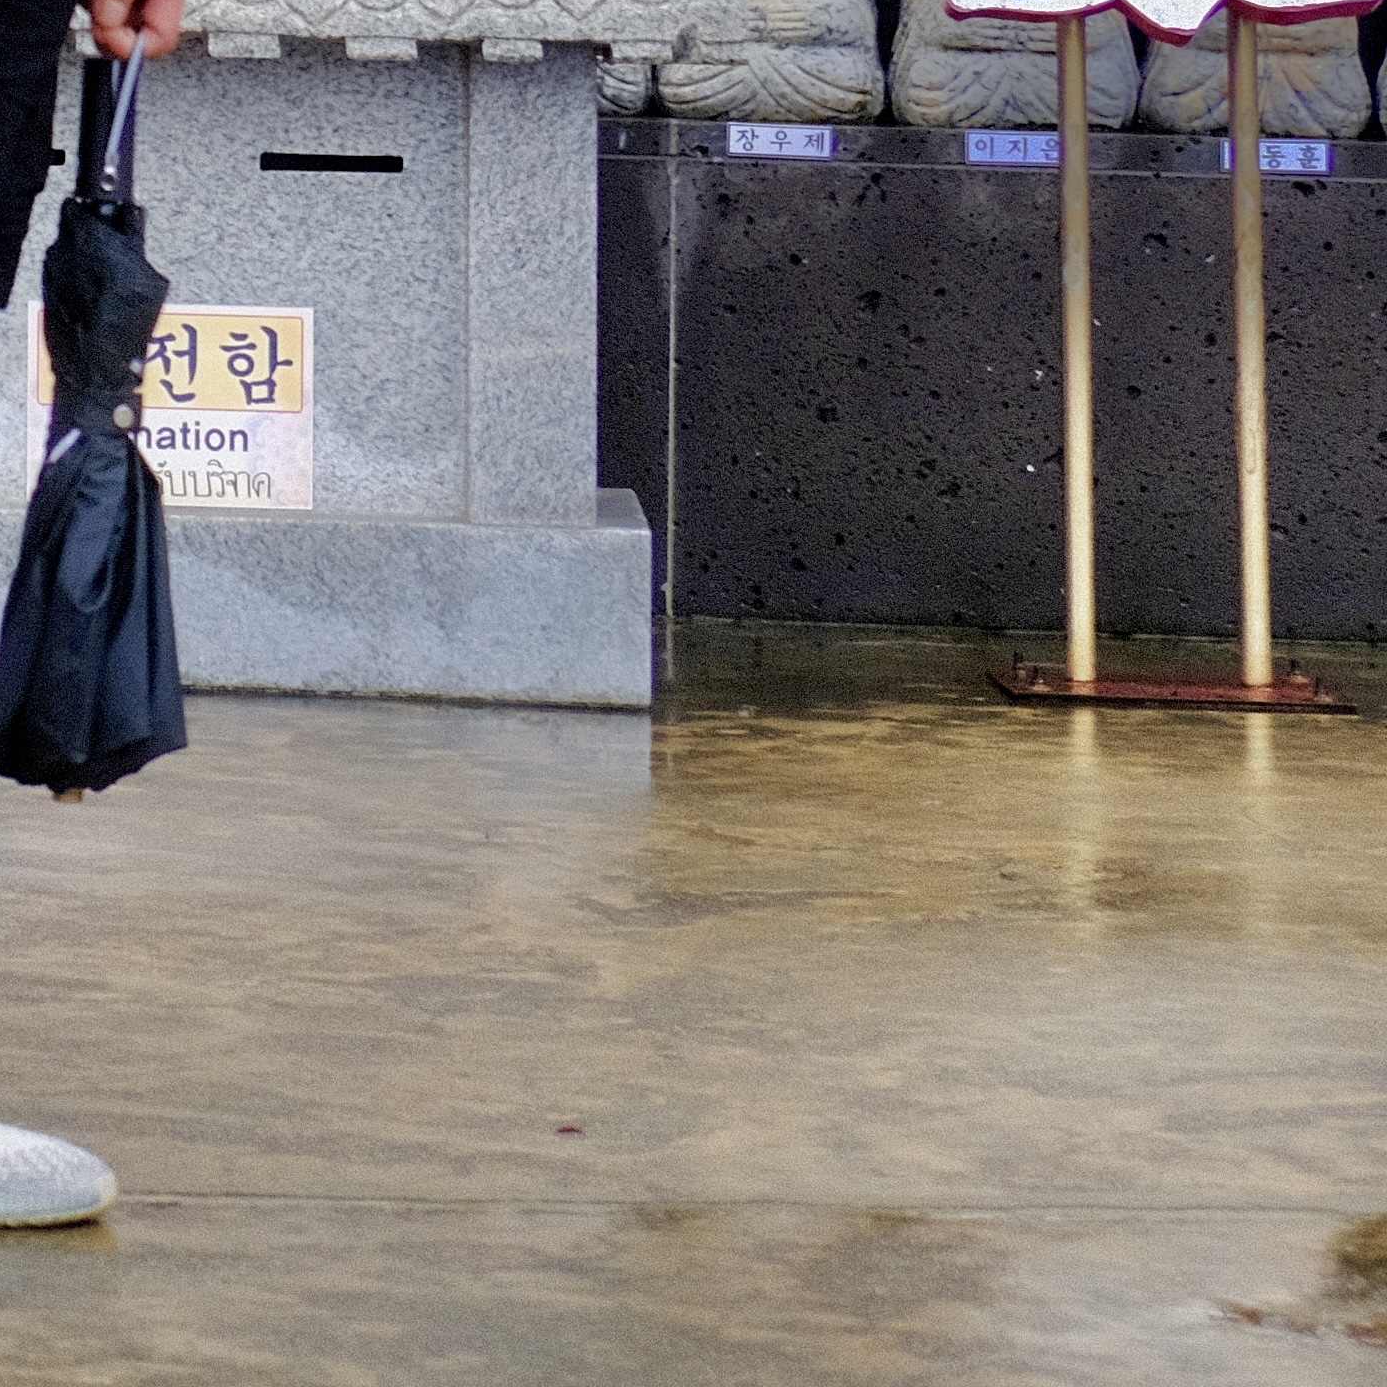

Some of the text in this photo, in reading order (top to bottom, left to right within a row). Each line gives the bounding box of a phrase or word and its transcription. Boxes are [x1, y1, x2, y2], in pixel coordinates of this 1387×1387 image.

[736, 129, 824, 151] 장우제
[142, 323, 293, 405] 전함
[135, 420, 249, 452] nation
